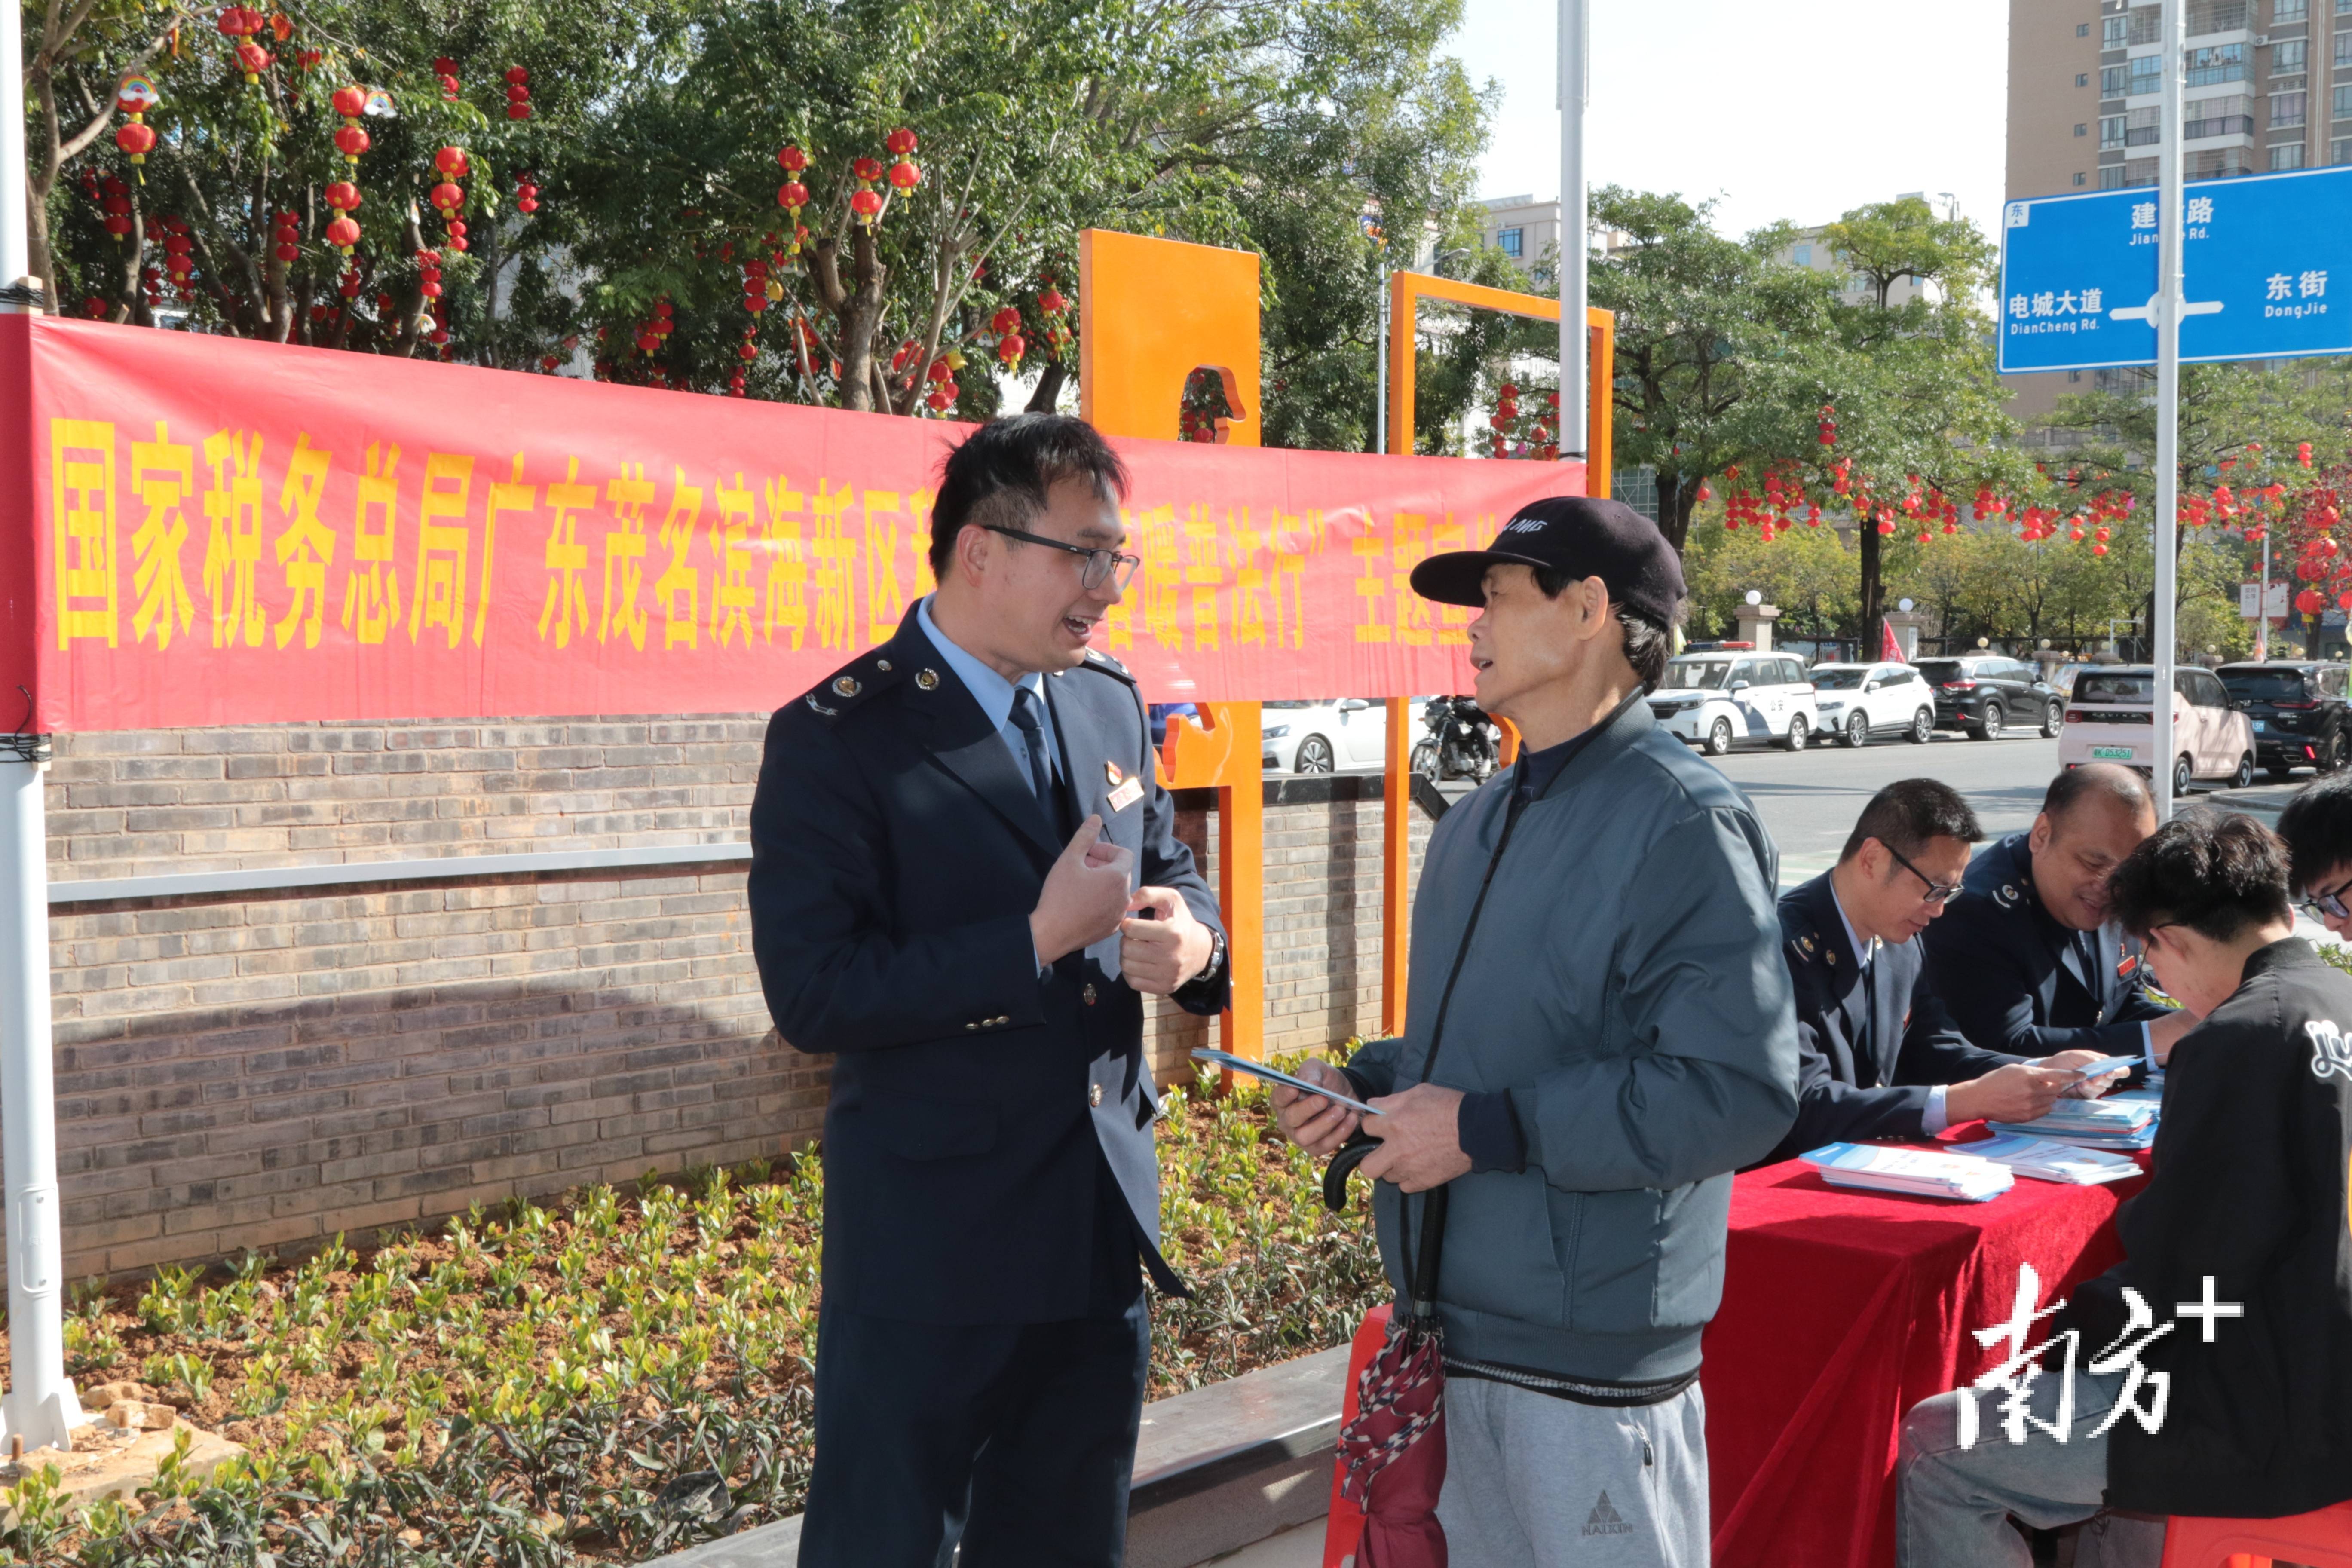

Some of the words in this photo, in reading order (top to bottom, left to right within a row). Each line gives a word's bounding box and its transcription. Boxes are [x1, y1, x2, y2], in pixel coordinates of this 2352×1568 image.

[2011, 204, 2023, 217] 东
[2131, 196, 2214, 229] 建路
[2189, 227, 2210, 239] Rd.
[2266, 270, 2328, 300] 东街
[2009, 288, 2103, 318] 电城大道
[2265, 302, 2328, 319] DongJie
[2011, 321, 2076, 335] DianCheng
[2081, 318, 2100, 330] Rd.
[1770, 699, 1784, 711] 公安
[1581, 1522, 1633, 1536] NAIXIN
